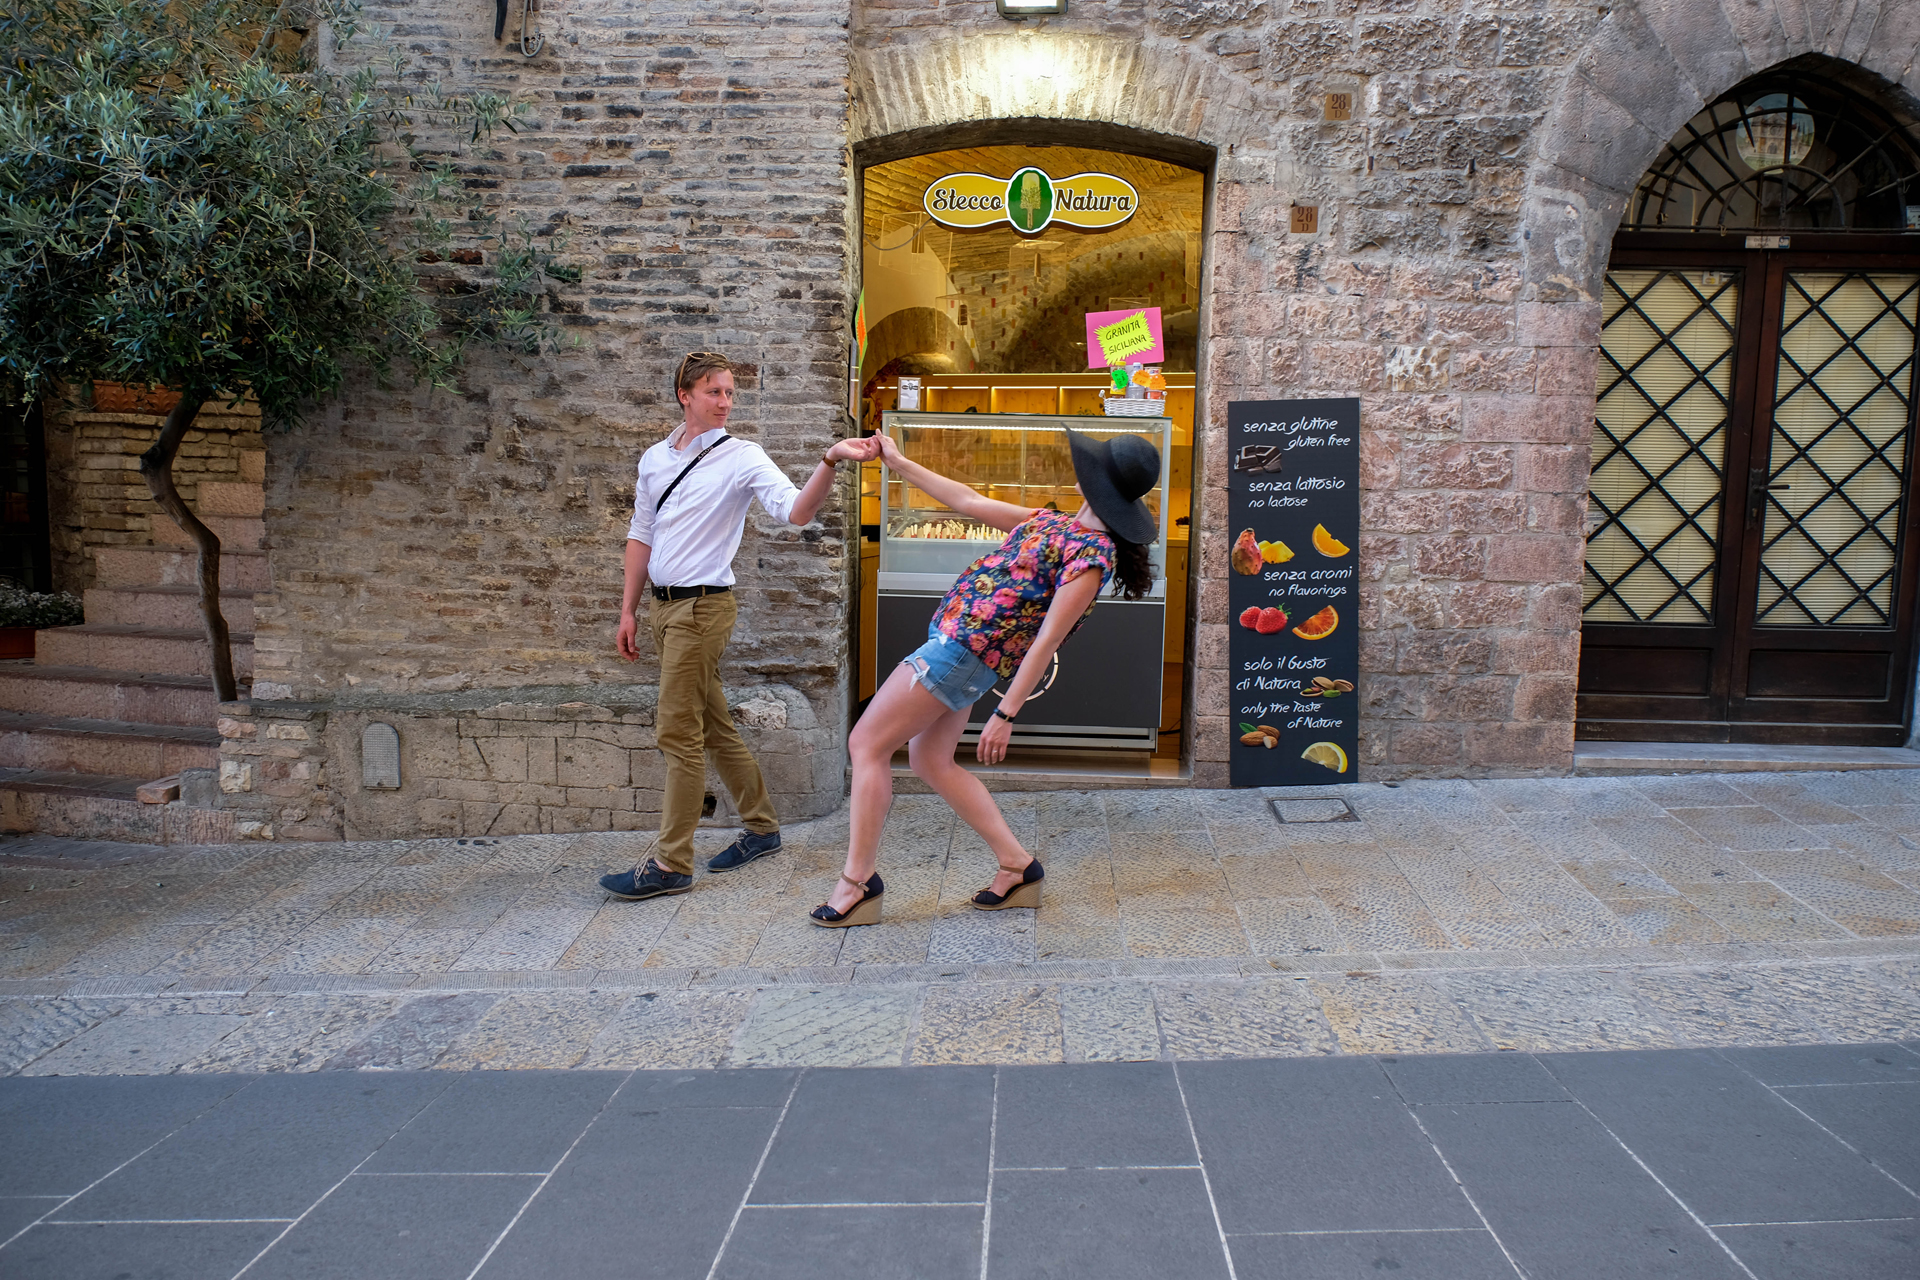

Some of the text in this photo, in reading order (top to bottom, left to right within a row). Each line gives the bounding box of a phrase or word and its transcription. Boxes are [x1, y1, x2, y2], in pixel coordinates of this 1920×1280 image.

[1331, 94, 1346, 109] 28
[1334, 110, 1342, 118] D
[932, 188, 1132, 212] Stecco Natura
[1297, 207, 1312, 222] 28
[1301, 223, 1309, 231] D
[1105, 320, 1141, 340] GRANITA
[1108, 334, 1147, 354] SICILIANA
[1243, 416, 1338, 434] senza glutine
[1283, 434, 1351, 450] gluten free
[1248, 476, 1346, 492] senza lattosio
[1248, 495, 1308, 508] no lactose
[1263, 566, 1353, 581] senza aromi
[1268, 584, 1347, 598] no flavorings
[1243, 655, 1332, 671] solo il Gusto
[1236, 675, 1302, 691] di Natura
[1241, 700, 1324, 719] only the Taste
[1287, 716, 1343, 729] of Nature
